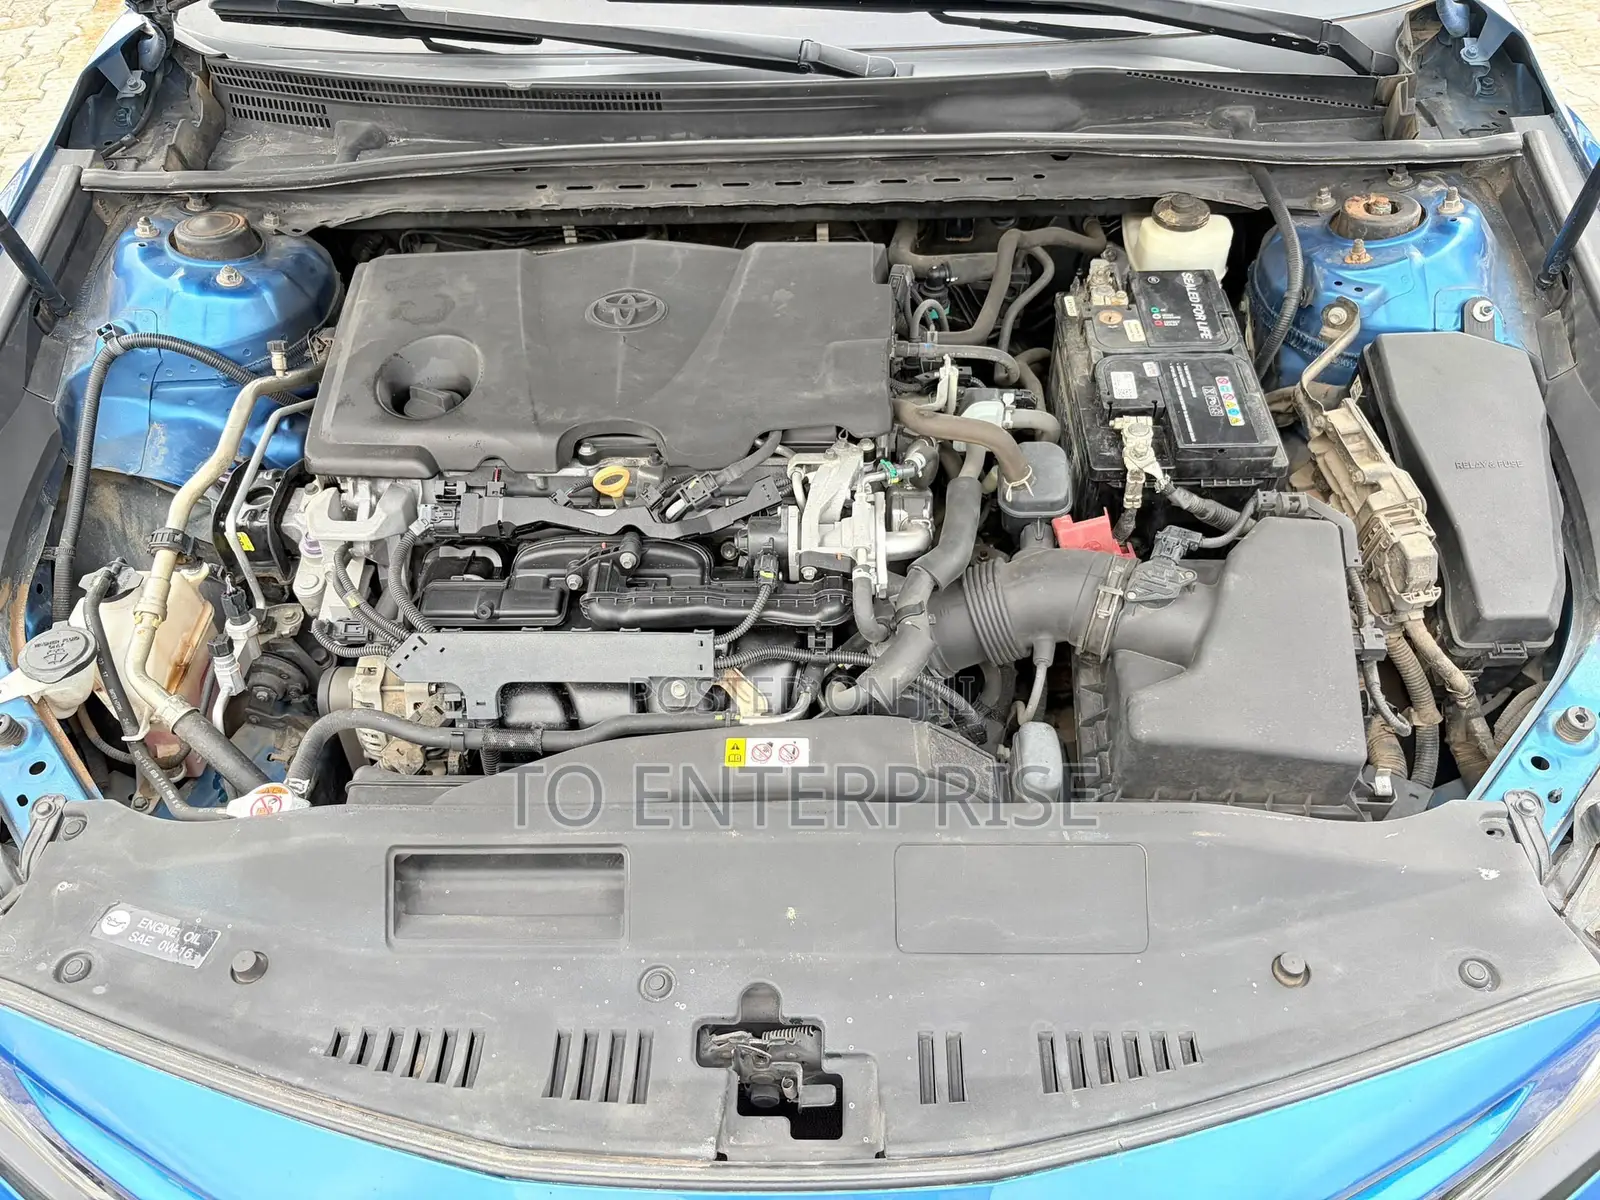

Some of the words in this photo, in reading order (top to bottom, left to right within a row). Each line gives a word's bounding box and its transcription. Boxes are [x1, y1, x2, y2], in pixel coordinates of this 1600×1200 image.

[1181, 272, 1201, 303] SEALED
[1191, 303, 1207, 321] FOR
[1196, 321, 1213, 339] LIFE
[1454, 460, 1486, 470] RELAY
[1487, 460, 1496, 469] &
[1497, 459, 1524, 469] FUSE
[128, 930, 156, 947] SAE
[137, 917, 180, 938] ENGINE
[183, 930, 202, 946] OIL
